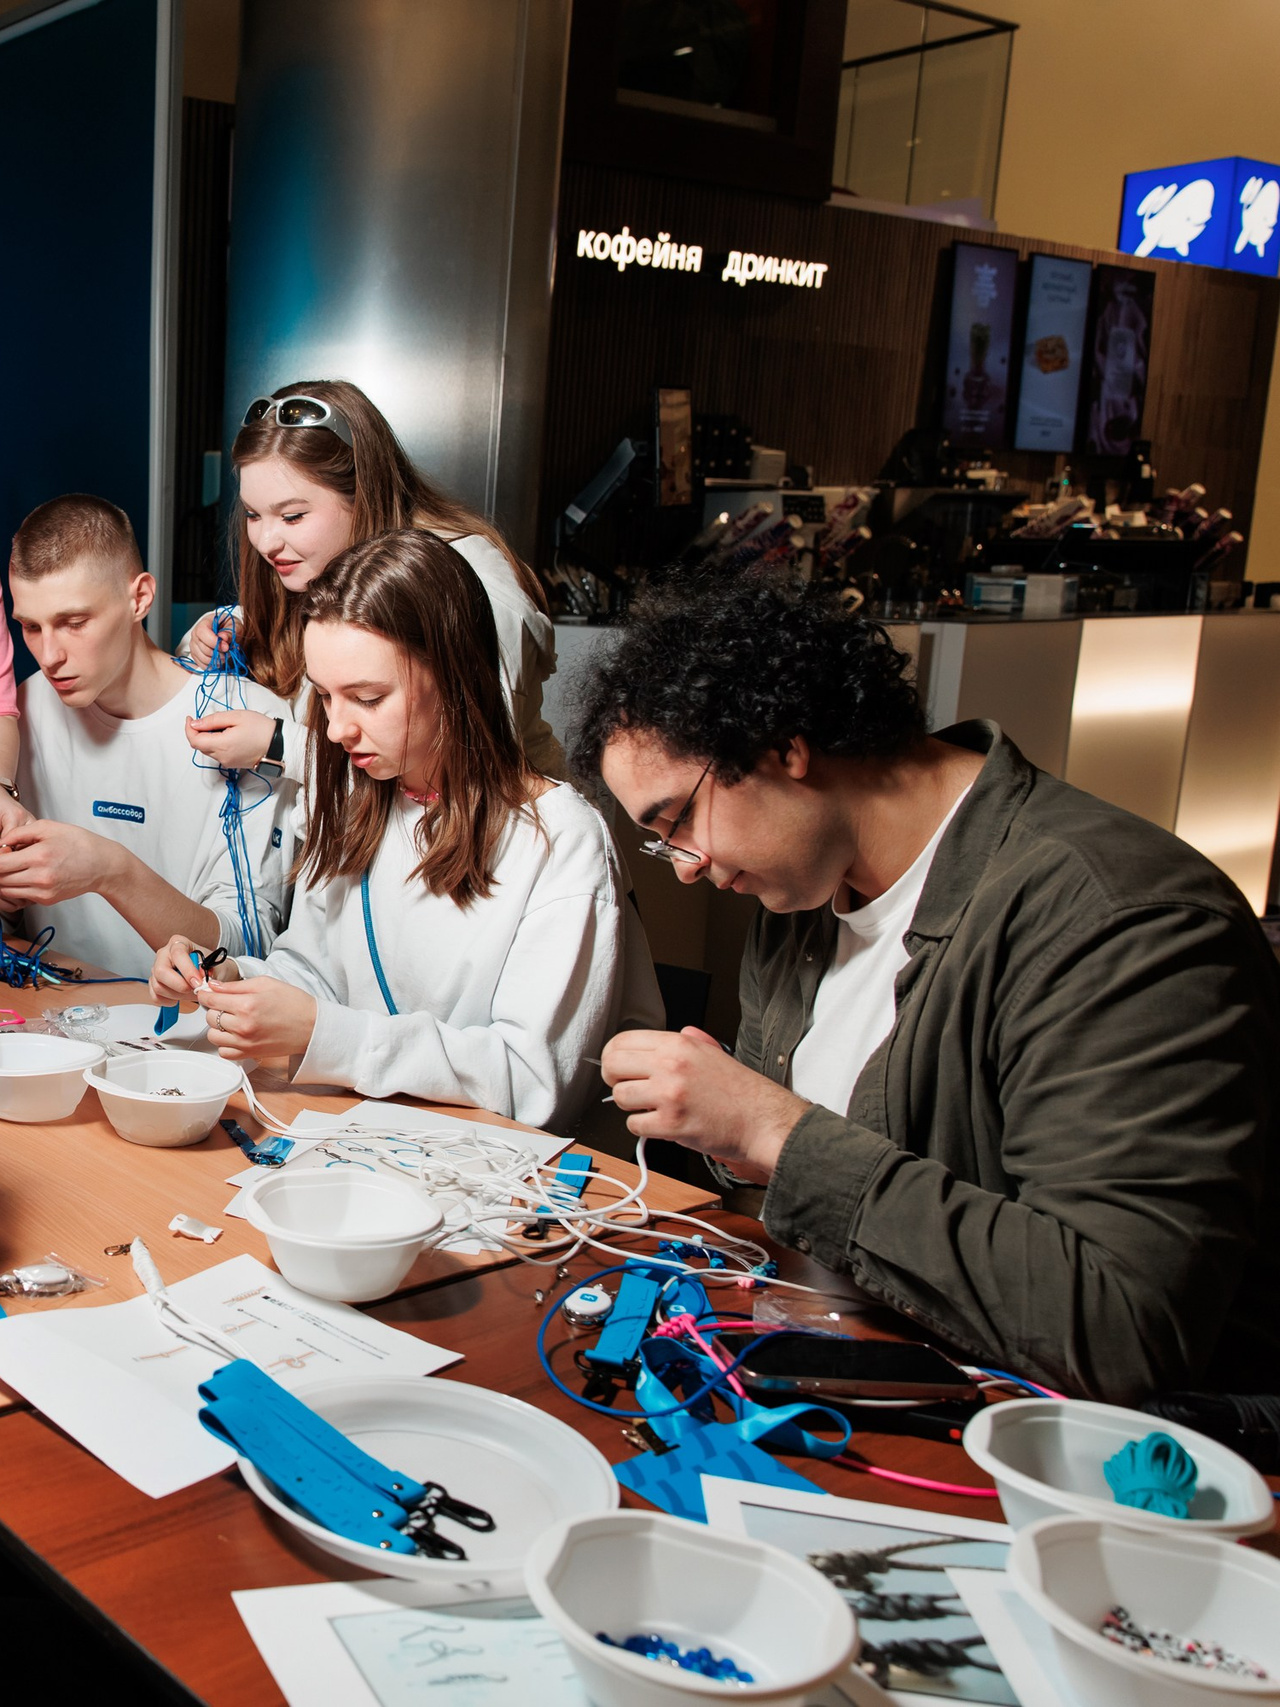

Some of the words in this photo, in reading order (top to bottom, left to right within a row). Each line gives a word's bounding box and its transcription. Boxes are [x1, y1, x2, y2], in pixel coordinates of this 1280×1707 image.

[576, 226, 703, 273] кофейня
[721, 250, 828, 289] дринкит
[97, 805, 143, 820] амбассадор
